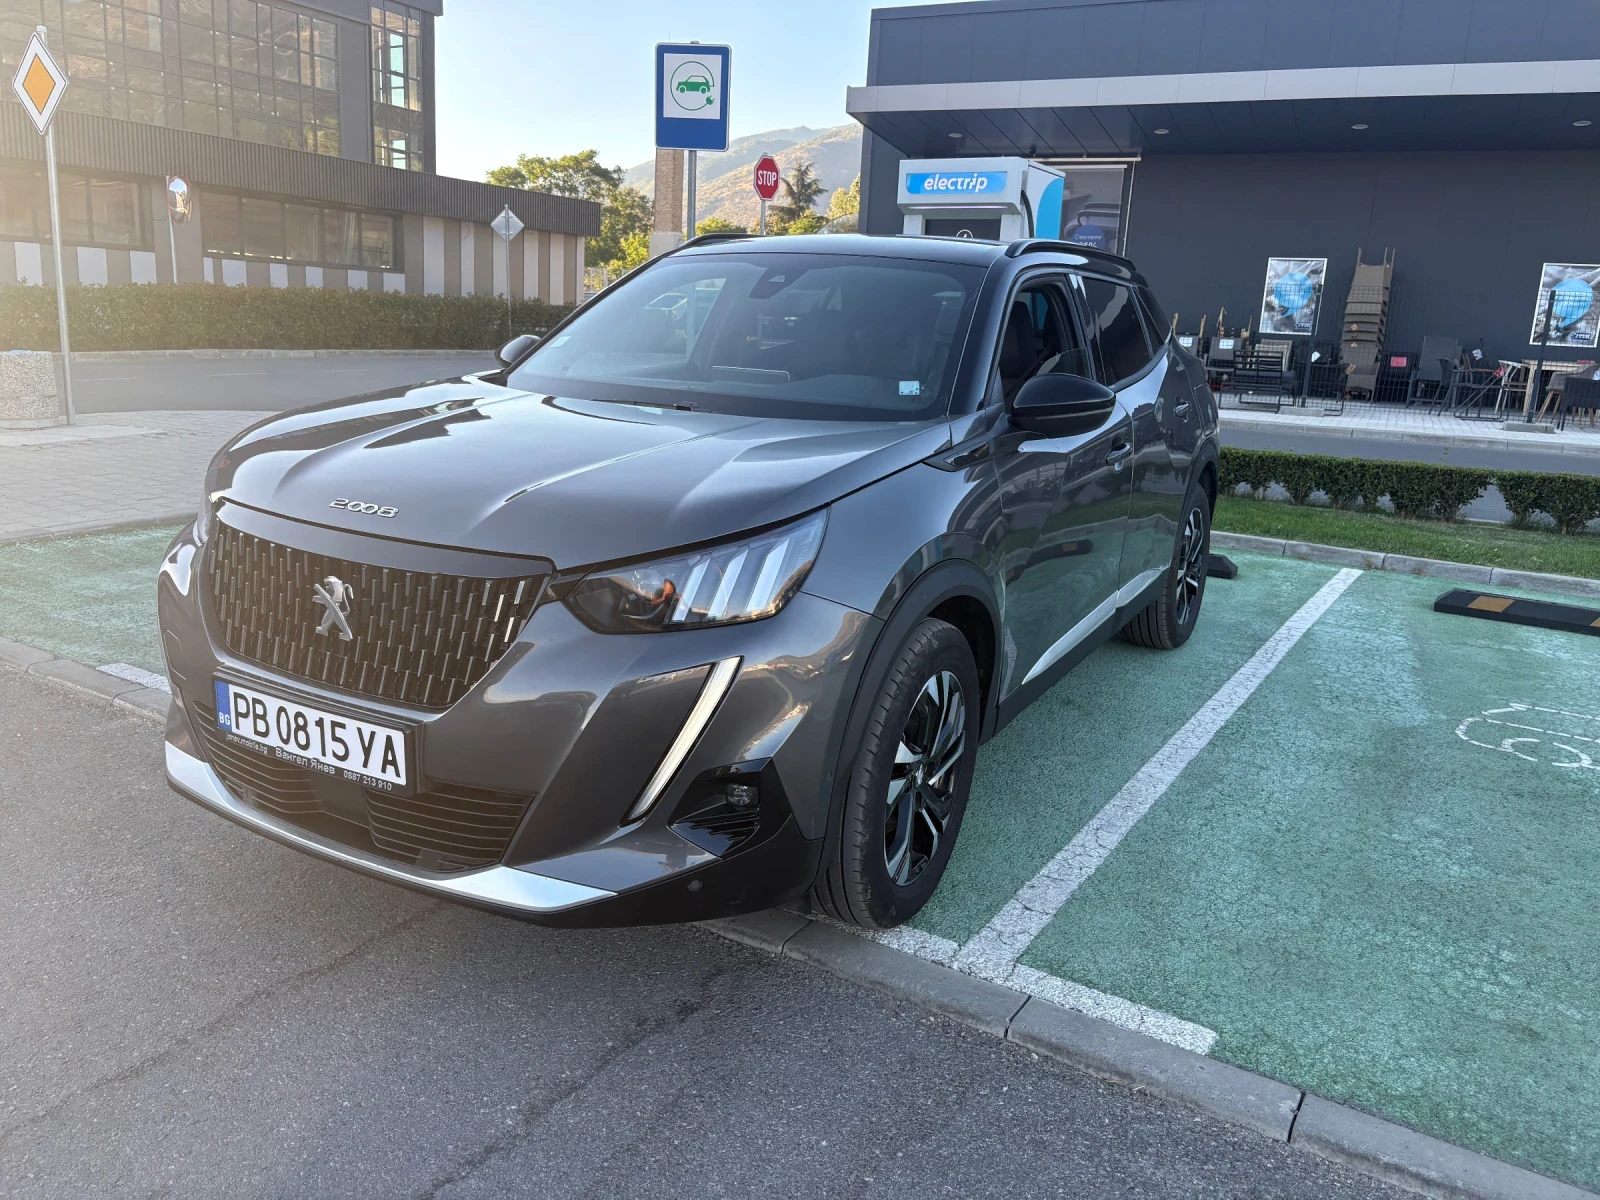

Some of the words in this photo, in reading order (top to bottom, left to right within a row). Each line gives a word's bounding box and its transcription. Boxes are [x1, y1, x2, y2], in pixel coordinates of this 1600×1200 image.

[757, 170, 777, 186] STOP
[923, 173, 988, 192] electrip
[328, 498, 399, 517] 2008
[219, 712, 231, 726] BG
[233, 692, 270, 739] PB
[276, 706, 350, 761] 0815
[357, 726, 401, 778] YA
[275, 747, 308, 766] Вангел
[311, 758, 336, 775] Янев
[362, 776, 377, 786] 213
